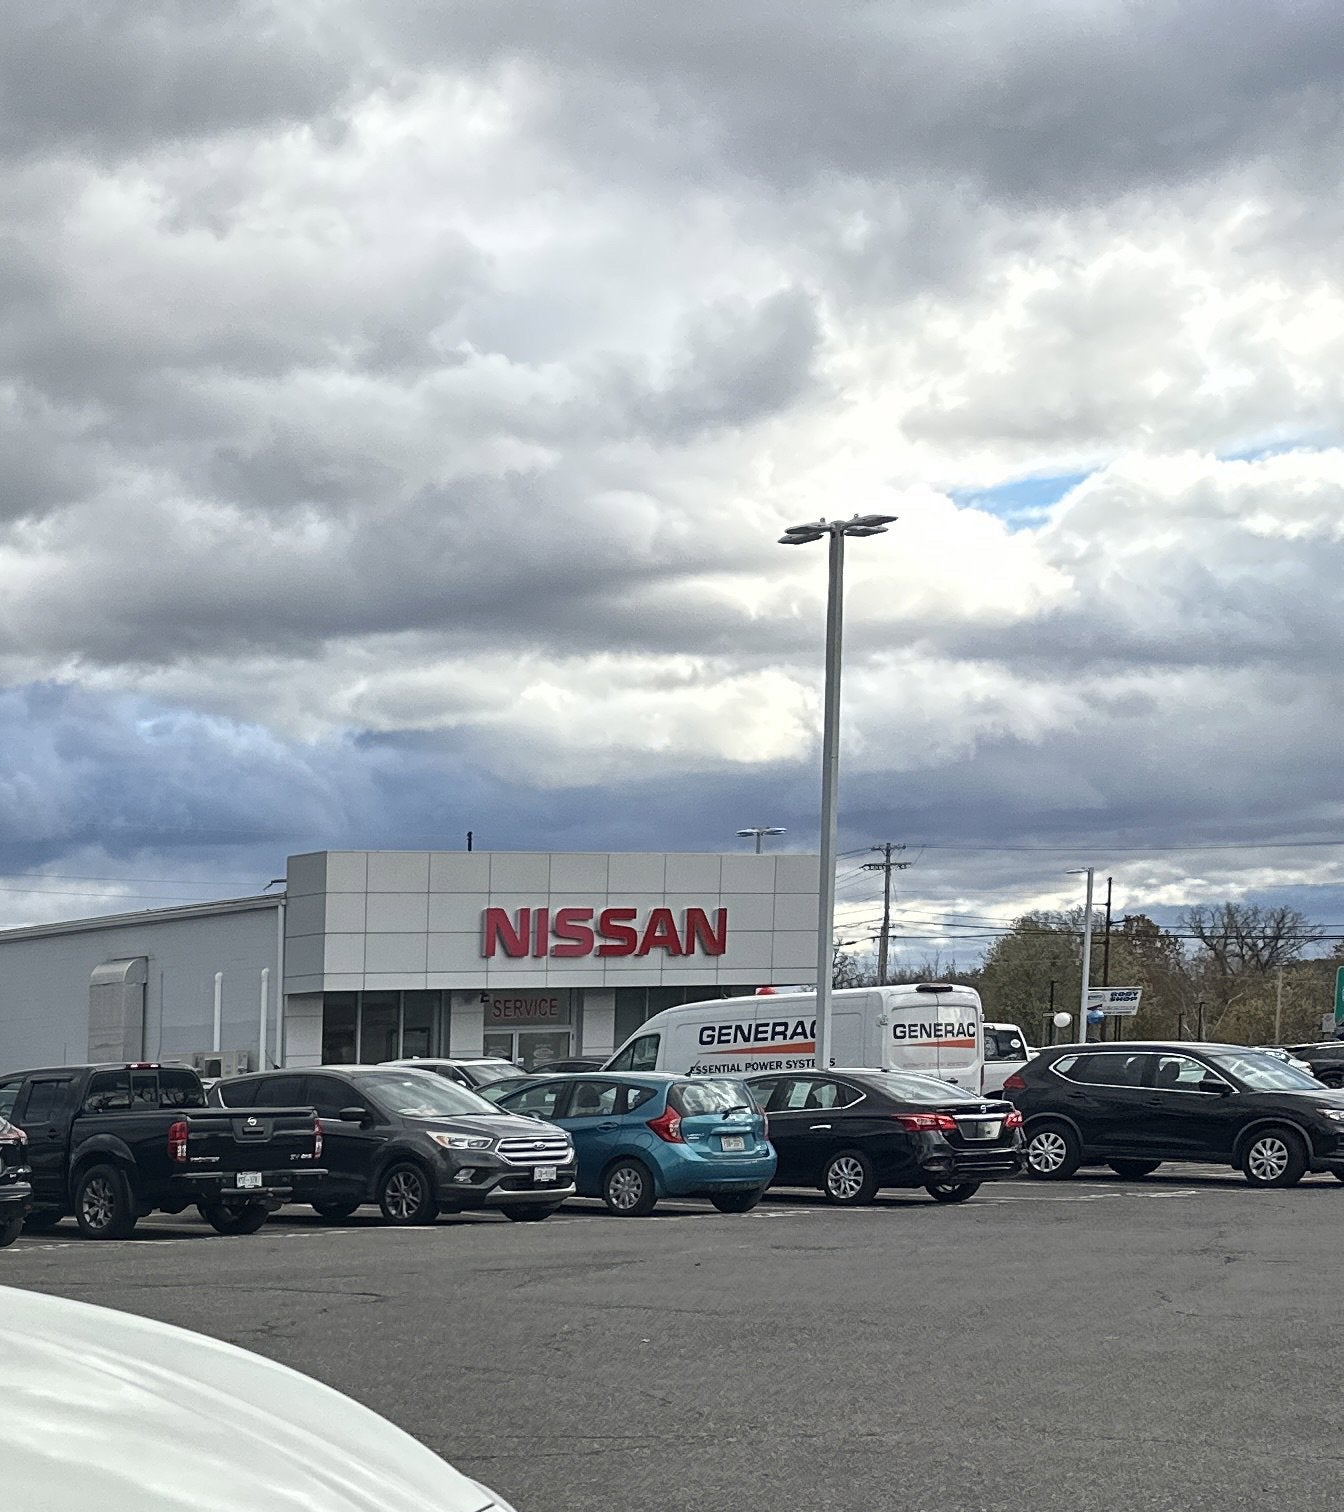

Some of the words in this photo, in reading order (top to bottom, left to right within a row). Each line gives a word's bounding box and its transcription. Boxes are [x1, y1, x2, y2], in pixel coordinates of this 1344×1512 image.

[482, 907, 728, 958] NISSAN
[492, 998, 559, 1018] SERVICE
[699, 1019, 817, 1046] GENERA
[892, 1022, 976, 1039] GENERAC
[690, 1063, 743, 1075] ESSENTIAL
[745, 1060, 783, 1072] POWER
[785, 1057, 836, 1070] SYSTES
